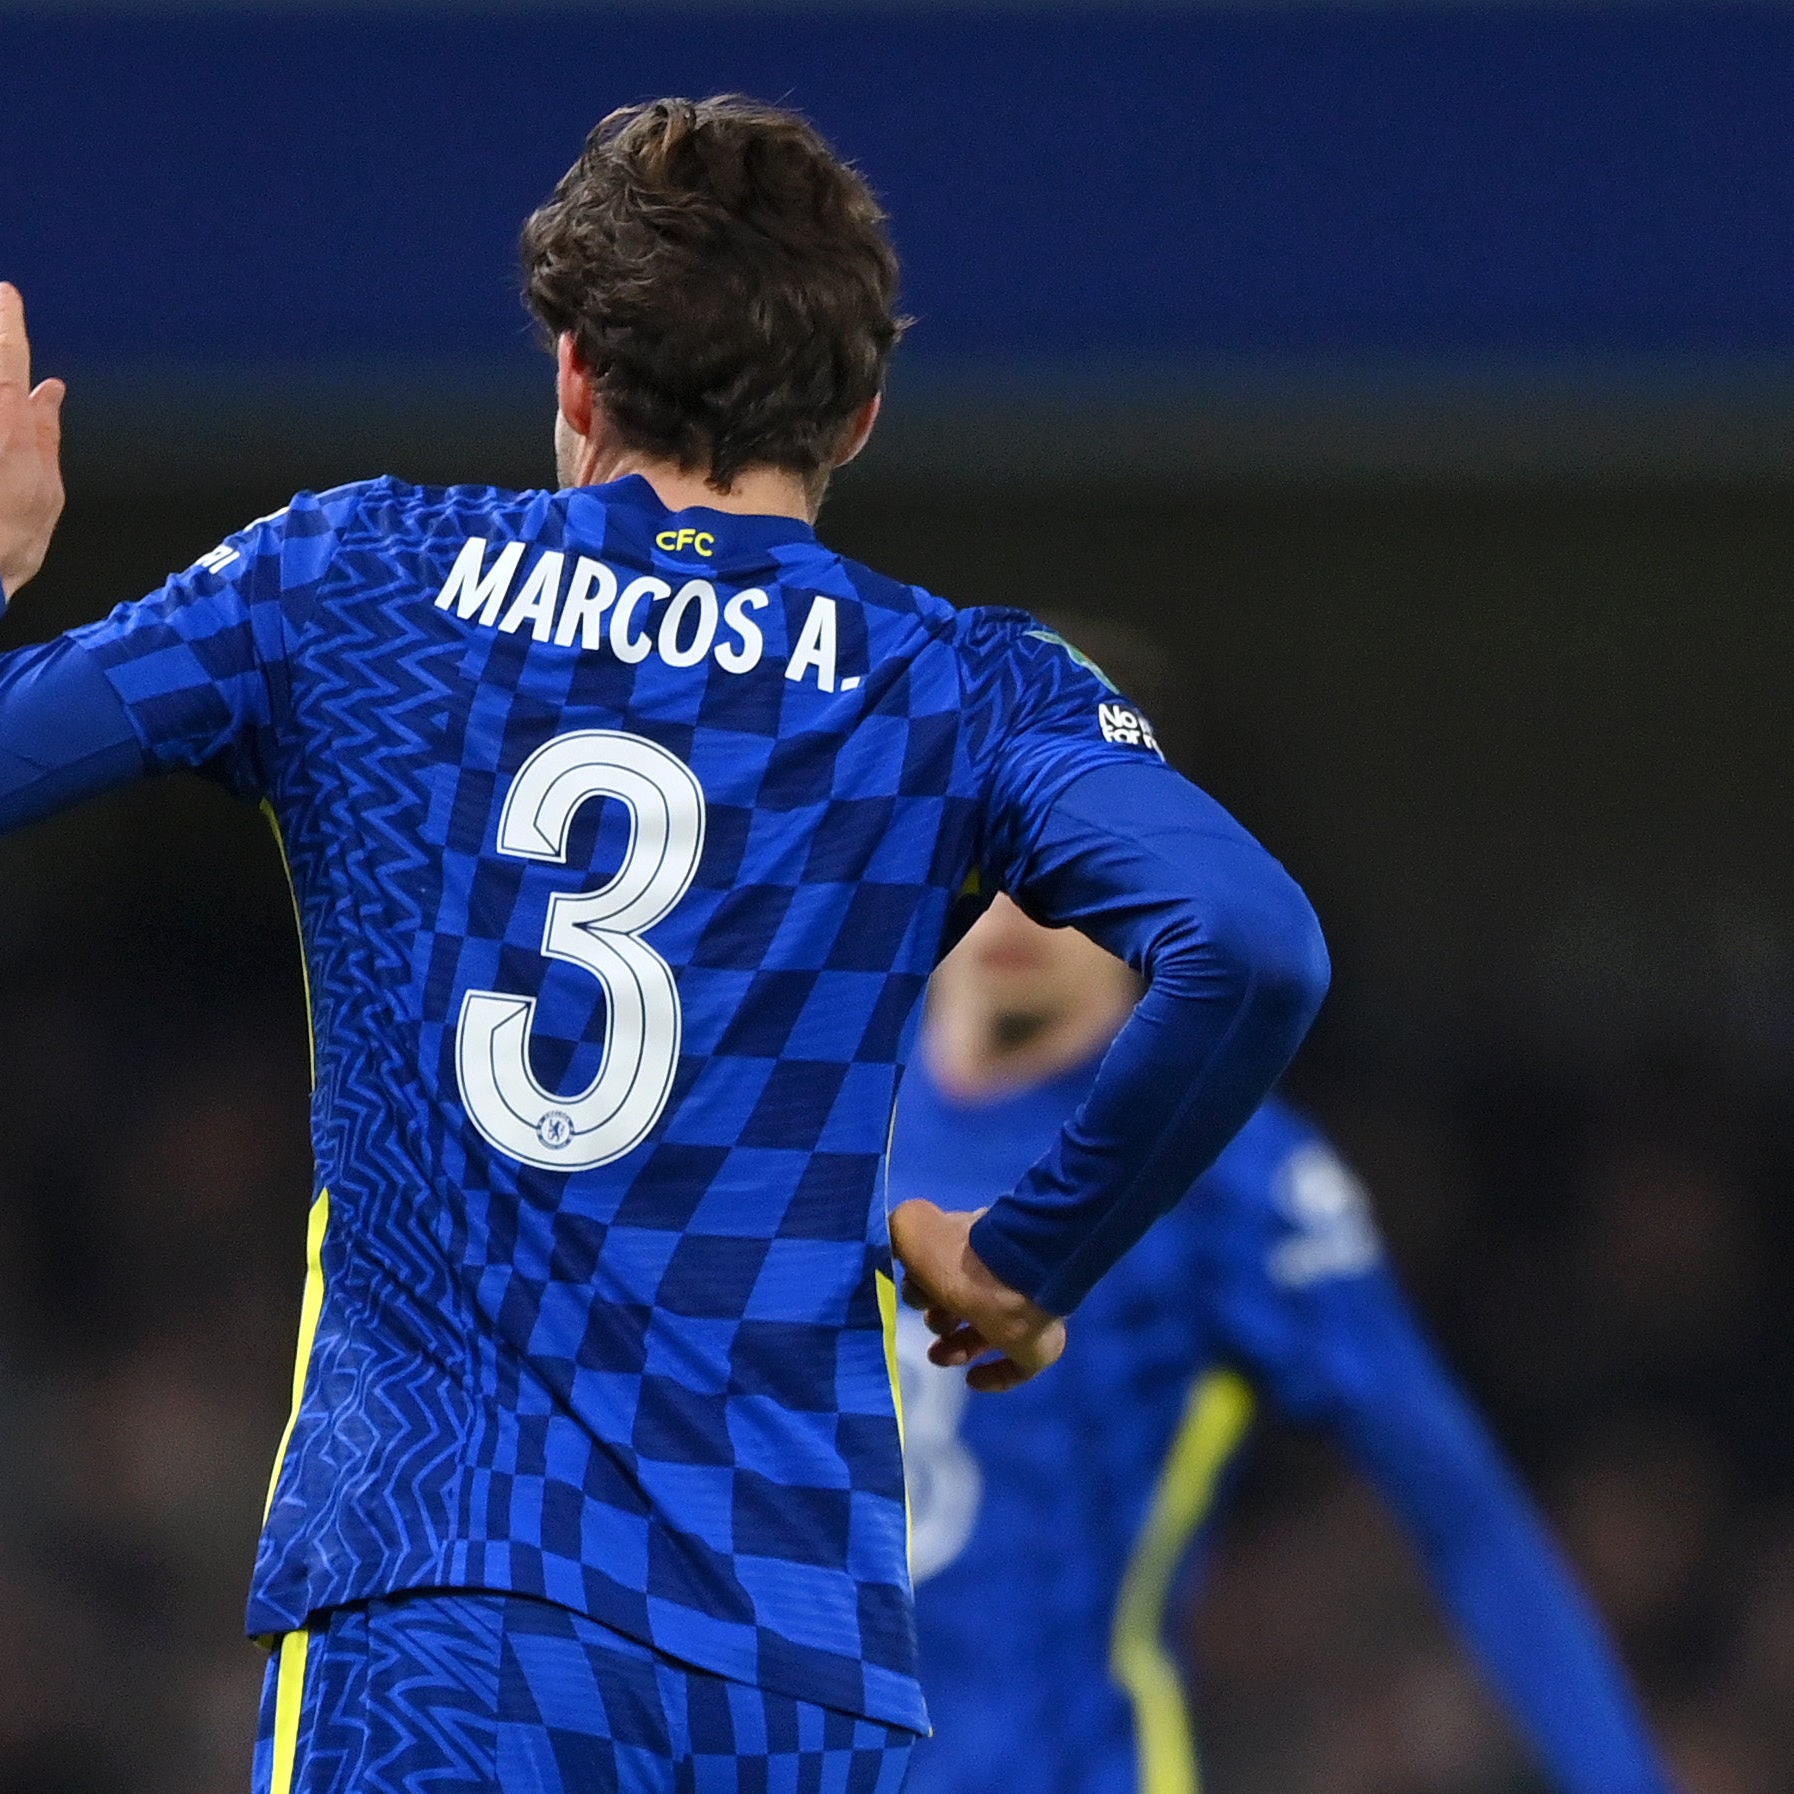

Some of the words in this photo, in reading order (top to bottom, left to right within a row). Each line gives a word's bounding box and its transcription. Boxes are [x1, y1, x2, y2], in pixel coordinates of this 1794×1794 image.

[655, 528, 715, 557] CFC
[436, 536, 770, 675] MARCOS
[784, 595, 862, 694] A.
[1098, 702, 1138, 729] No
[454, 728, 707, 1173] 3
